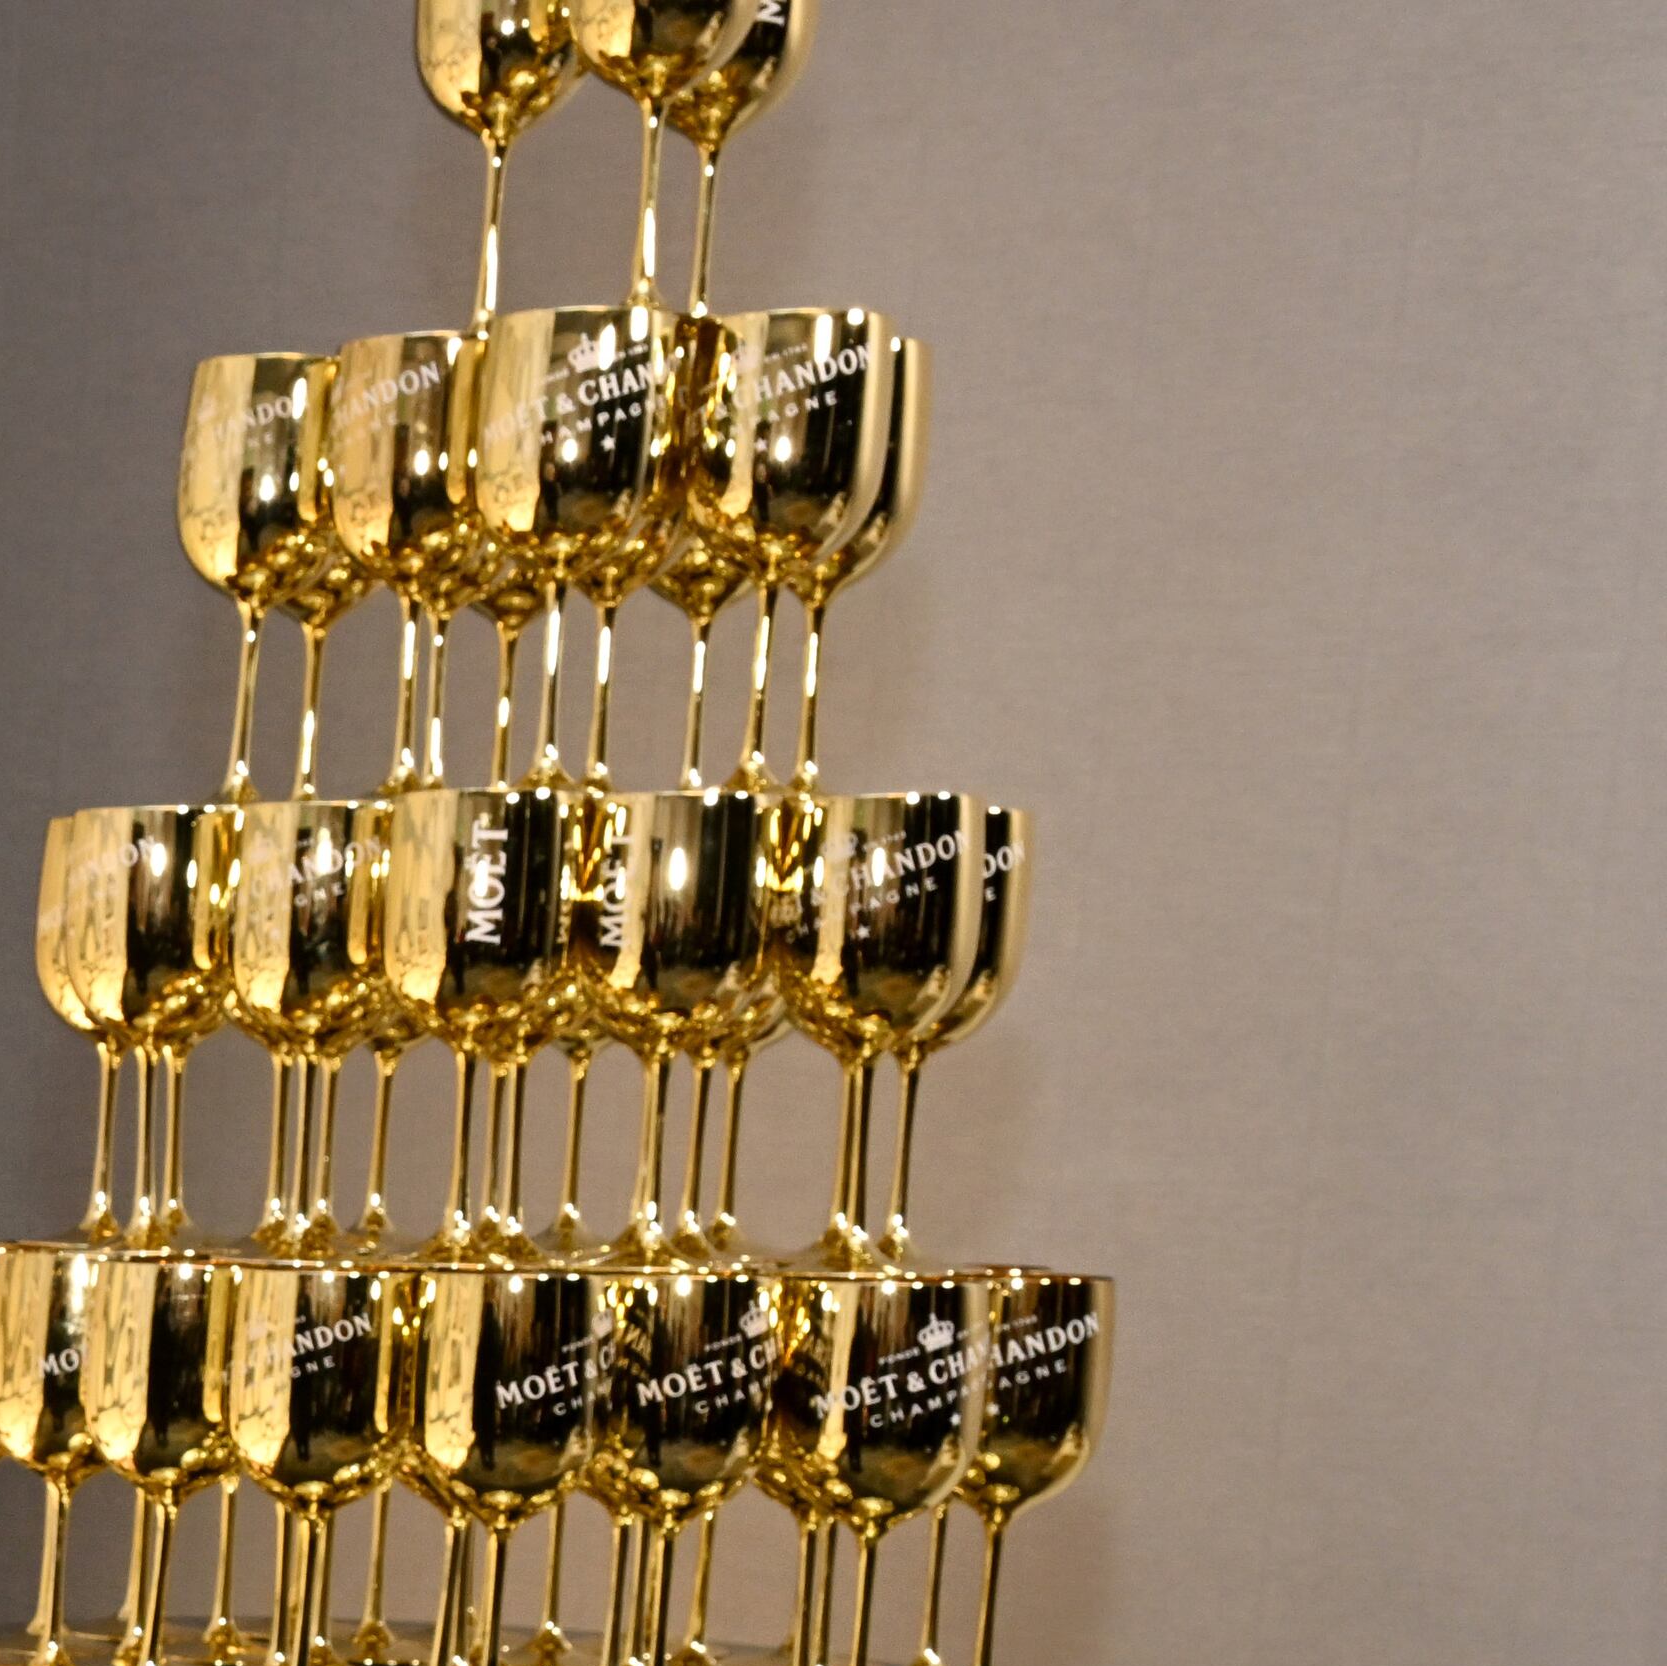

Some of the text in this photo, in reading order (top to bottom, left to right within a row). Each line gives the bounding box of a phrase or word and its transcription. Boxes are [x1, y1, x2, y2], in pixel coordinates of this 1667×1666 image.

[556, 391, 577, 415] &
[495, 1360, 579, 1411] MOËT
[584, 1357, 598, 1379] &
[636, 1359, 723, 1409] MOËT
[729, 1356, 749, 1379] &
[813, 1373, 899, 1420] MOËT
[906, 1370, 927, 1394] &
